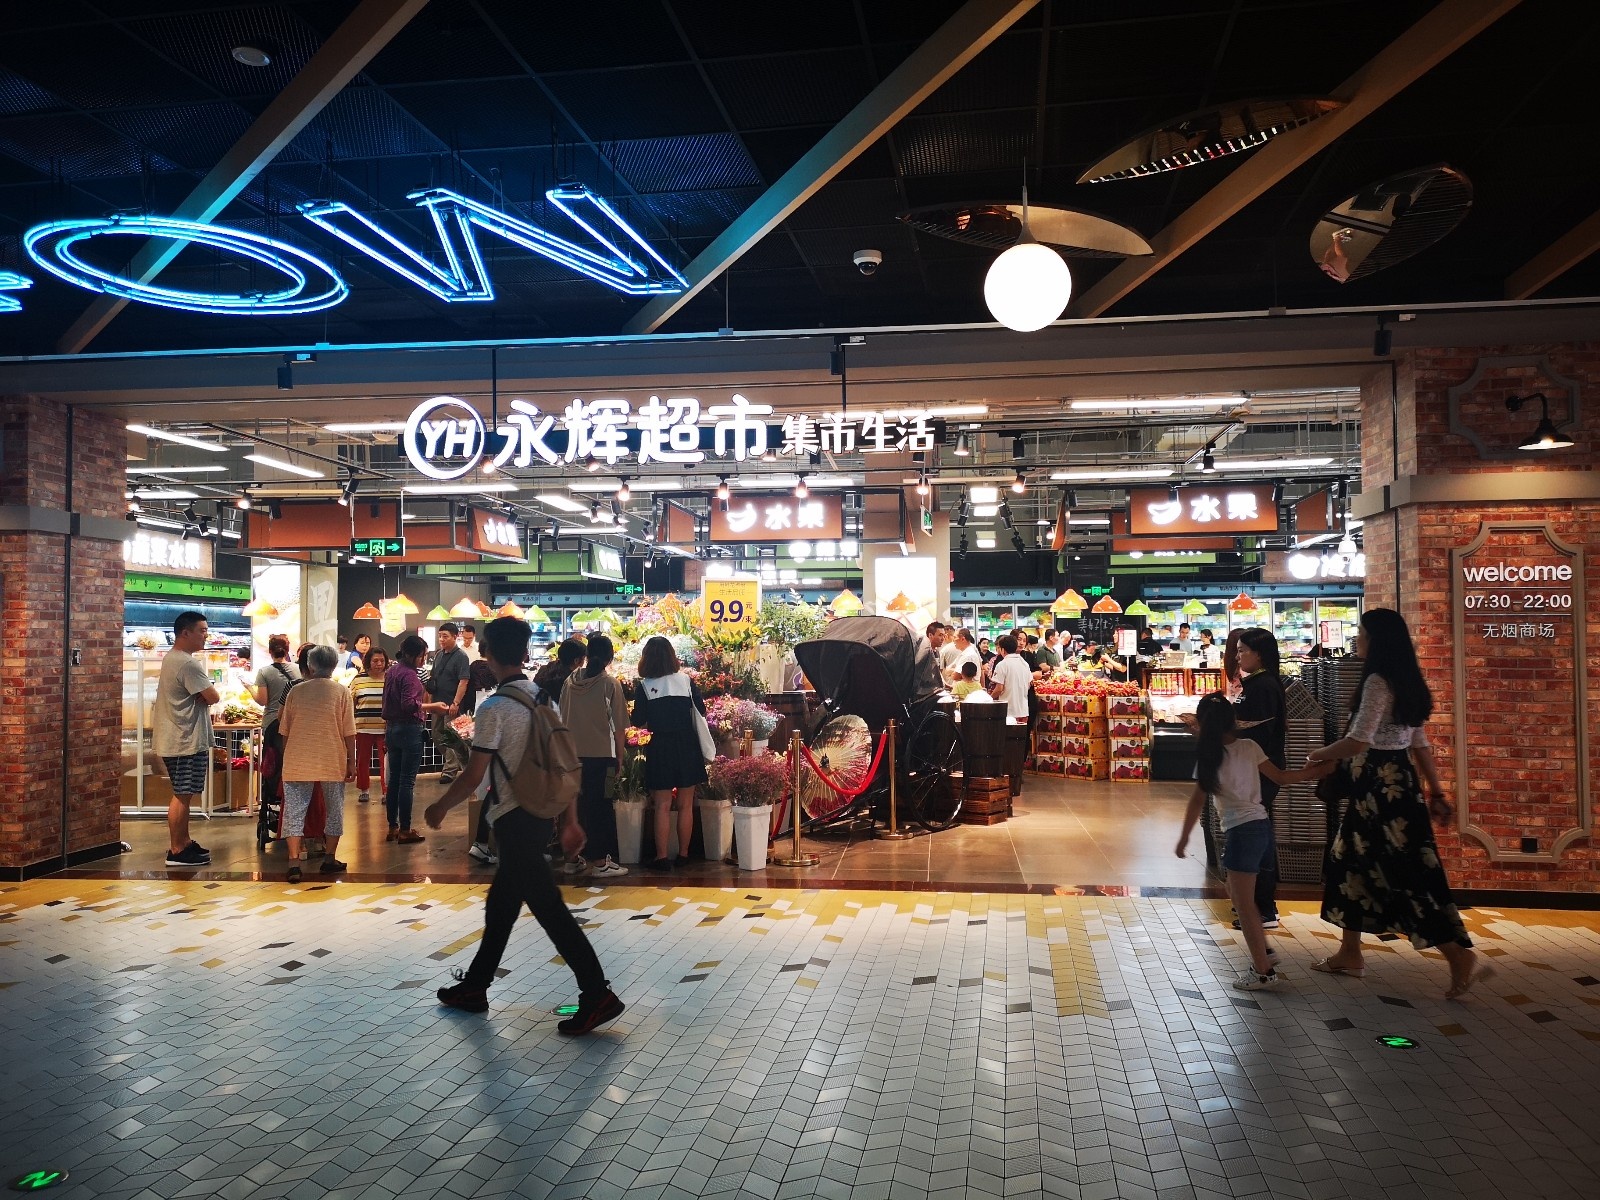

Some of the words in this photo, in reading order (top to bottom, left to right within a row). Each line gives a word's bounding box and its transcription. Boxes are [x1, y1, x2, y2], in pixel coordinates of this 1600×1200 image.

[0, 182, 690, 316] OW
[420, 419, 476, 458] YH
[492, 393, 775, 465] 永辉超市
[780, 410, 936, 455] 集市生活
[764, 503, 824, 529] 水果
[1191, 493, 1259, 522] 水果
[1463, 562, 1572, 582] welcome
[709, 599, 744, 623] 9.9
[1482, 623, 1555, 639] 无烟商场
